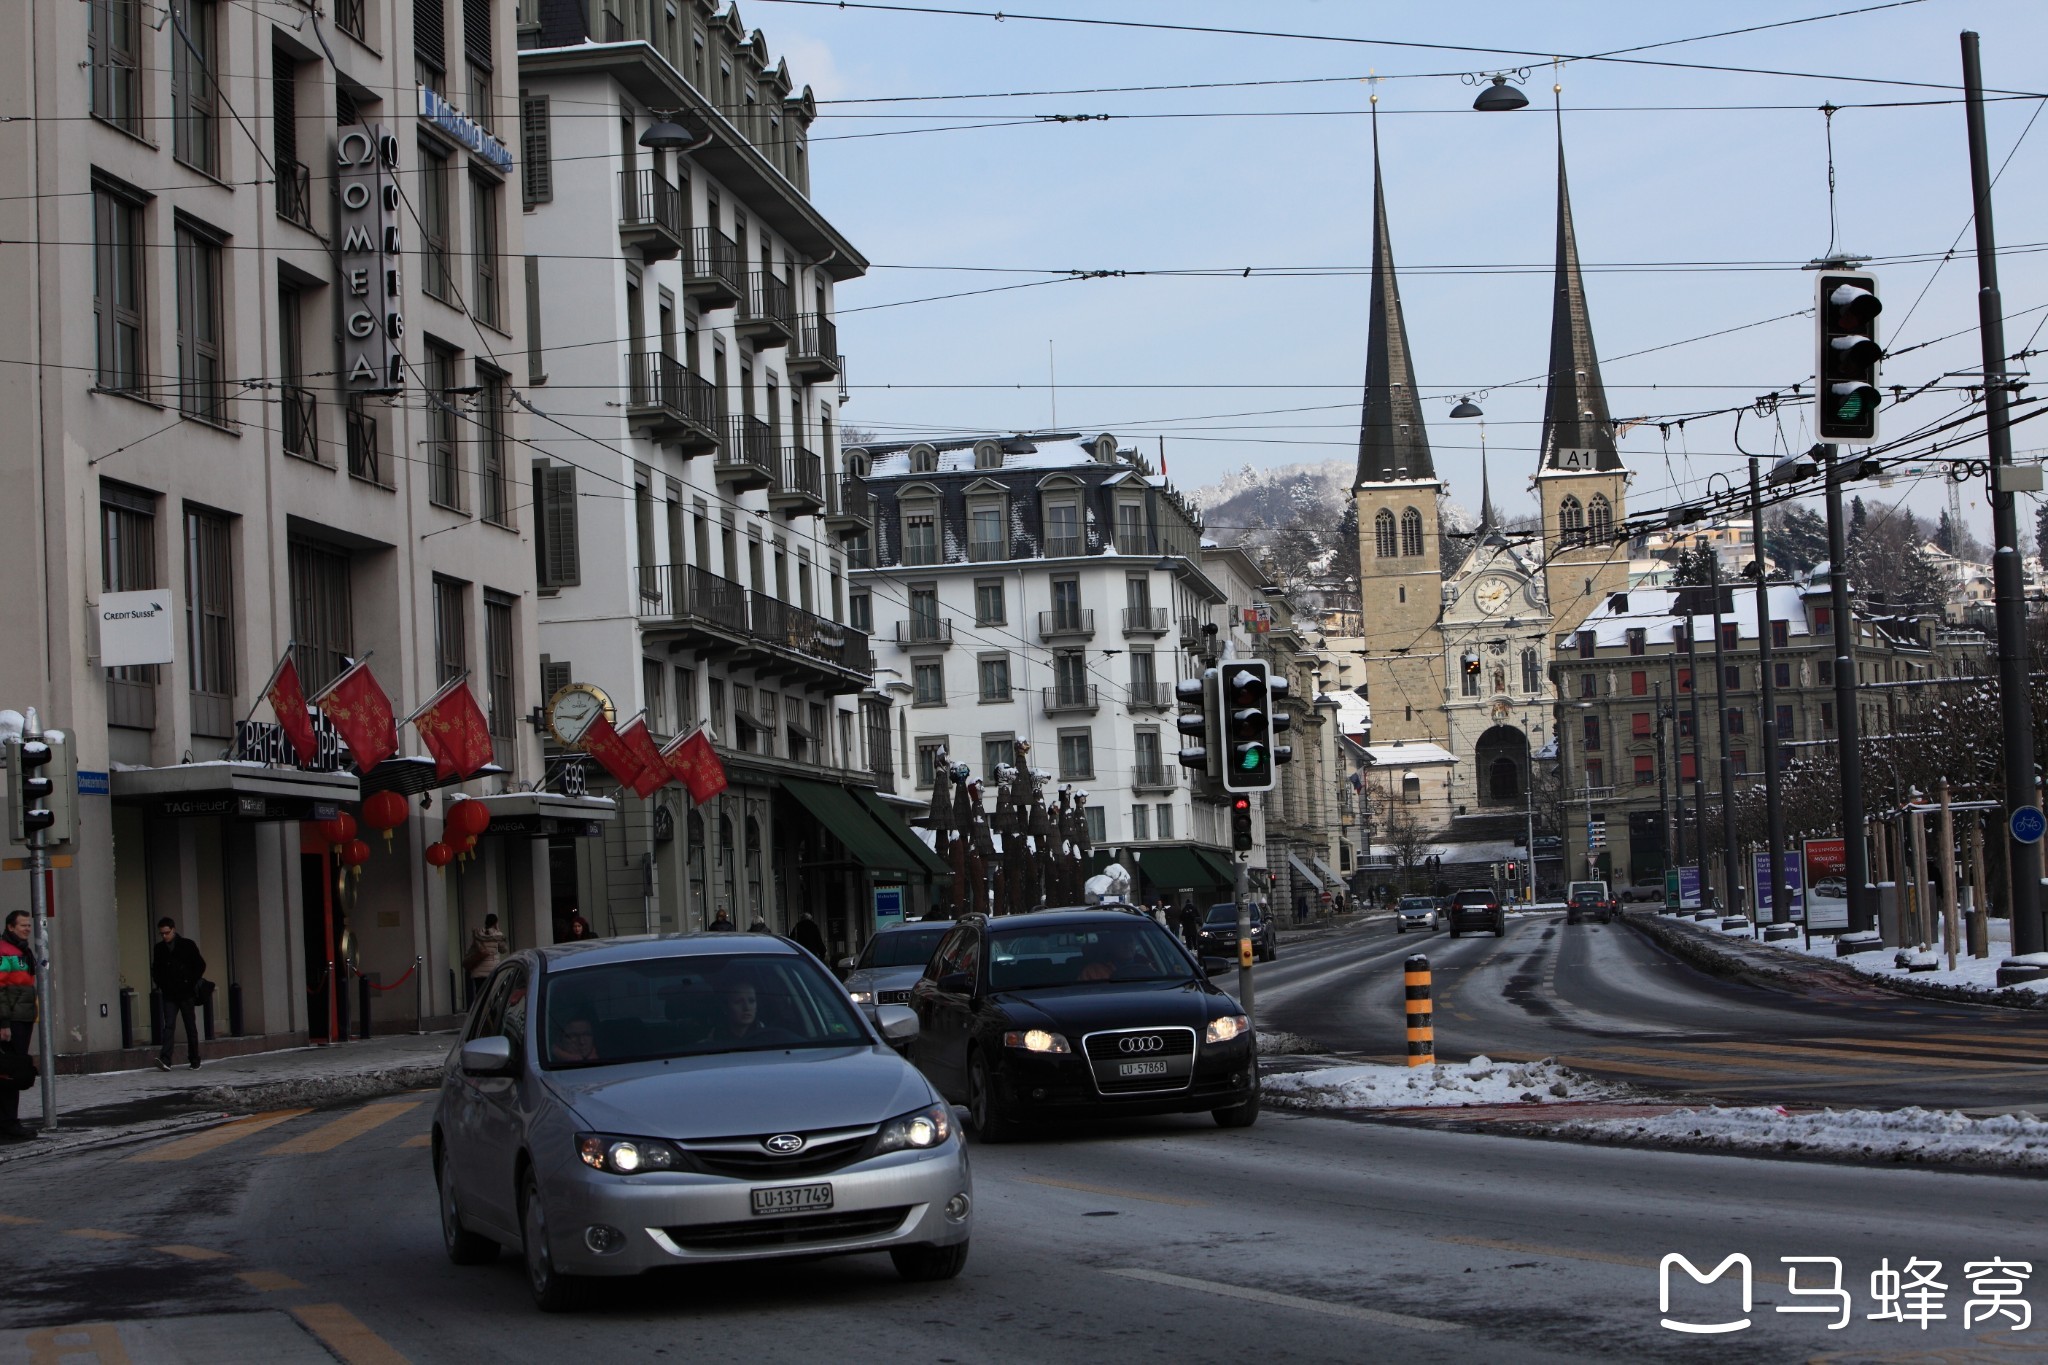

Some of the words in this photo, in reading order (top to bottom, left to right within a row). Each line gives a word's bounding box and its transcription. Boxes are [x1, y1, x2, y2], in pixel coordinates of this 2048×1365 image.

[342, 182, 377, 382] OMEGA
[384, 184, 406, 383] OMEGA
[1567, 450, 1589, 466] A1
[103, 611, 131, 621] CREDIT
[131, 610, 155, 619] SUISSE
[246, 720, 286, 764] PATEK
[565, 762, 589, 795] EBEL
[489, 821, 526, 832] OMEGA
